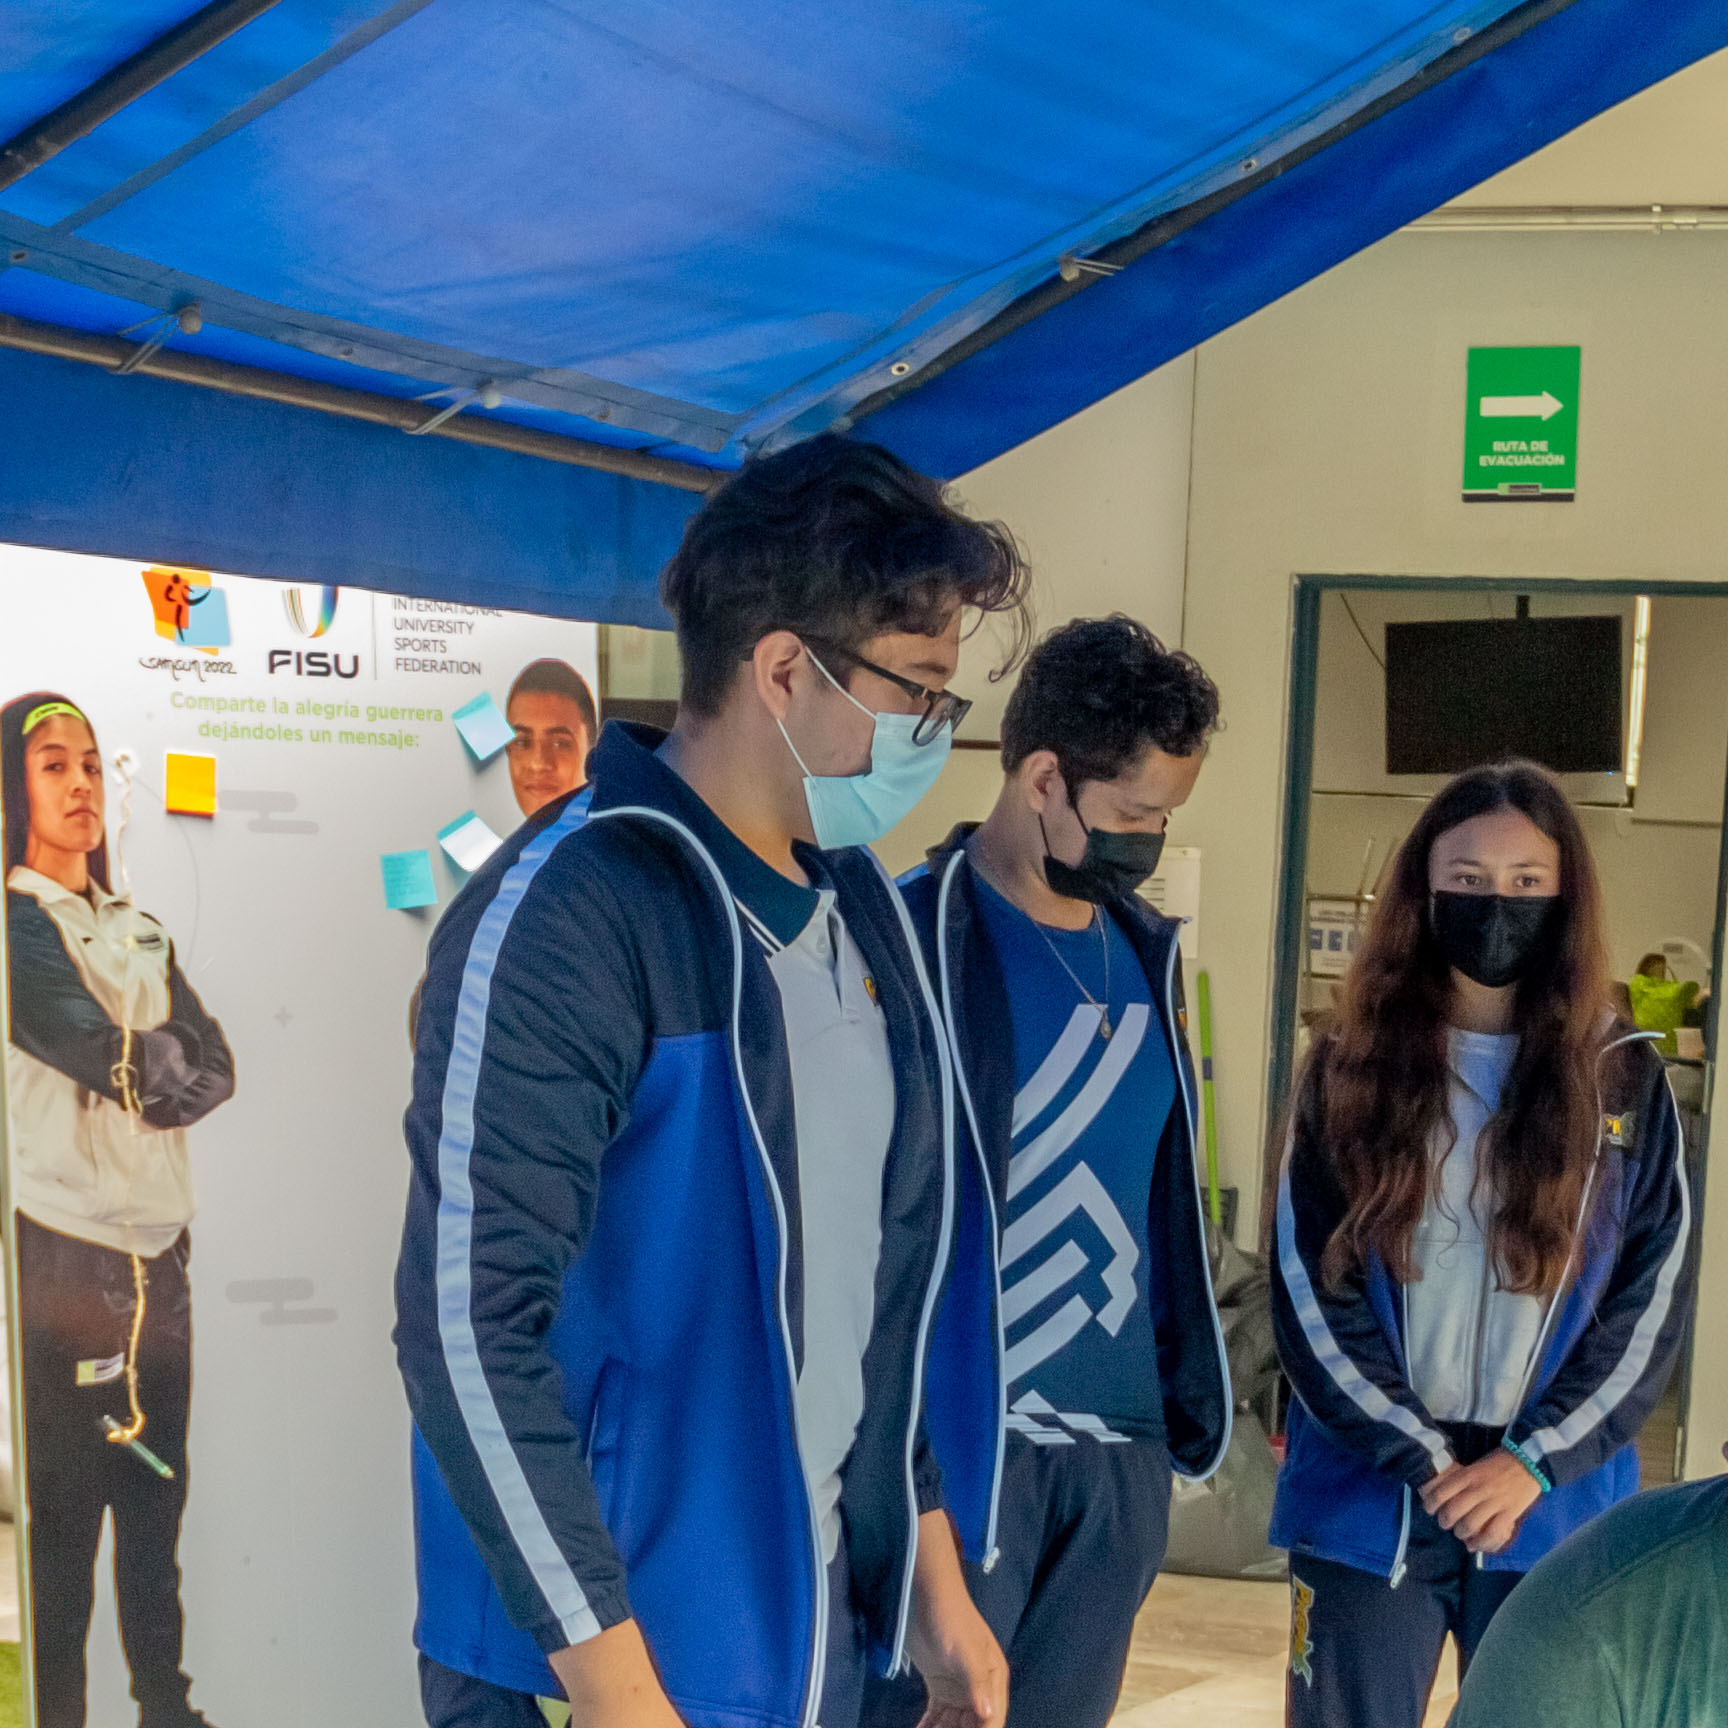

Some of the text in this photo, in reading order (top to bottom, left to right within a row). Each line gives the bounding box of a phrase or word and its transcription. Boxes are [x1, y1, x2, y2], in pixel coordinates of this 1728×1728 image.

[1492, 440, 1549, 452] RUTA DE
[393, 618, 474, 635] UNIVERSITY
[394, 637, 448, 654] SPORTS
[268, 649, 359, 679] FISU
[395, 657, 482, 675] FEDERATION
[170, 691, 268, 716] Comparte
[272, 697, 289, 715] la
[365, 703, 445, 723] guerrera
[198, 720, 421, 750] dejándoles un mensaje:
